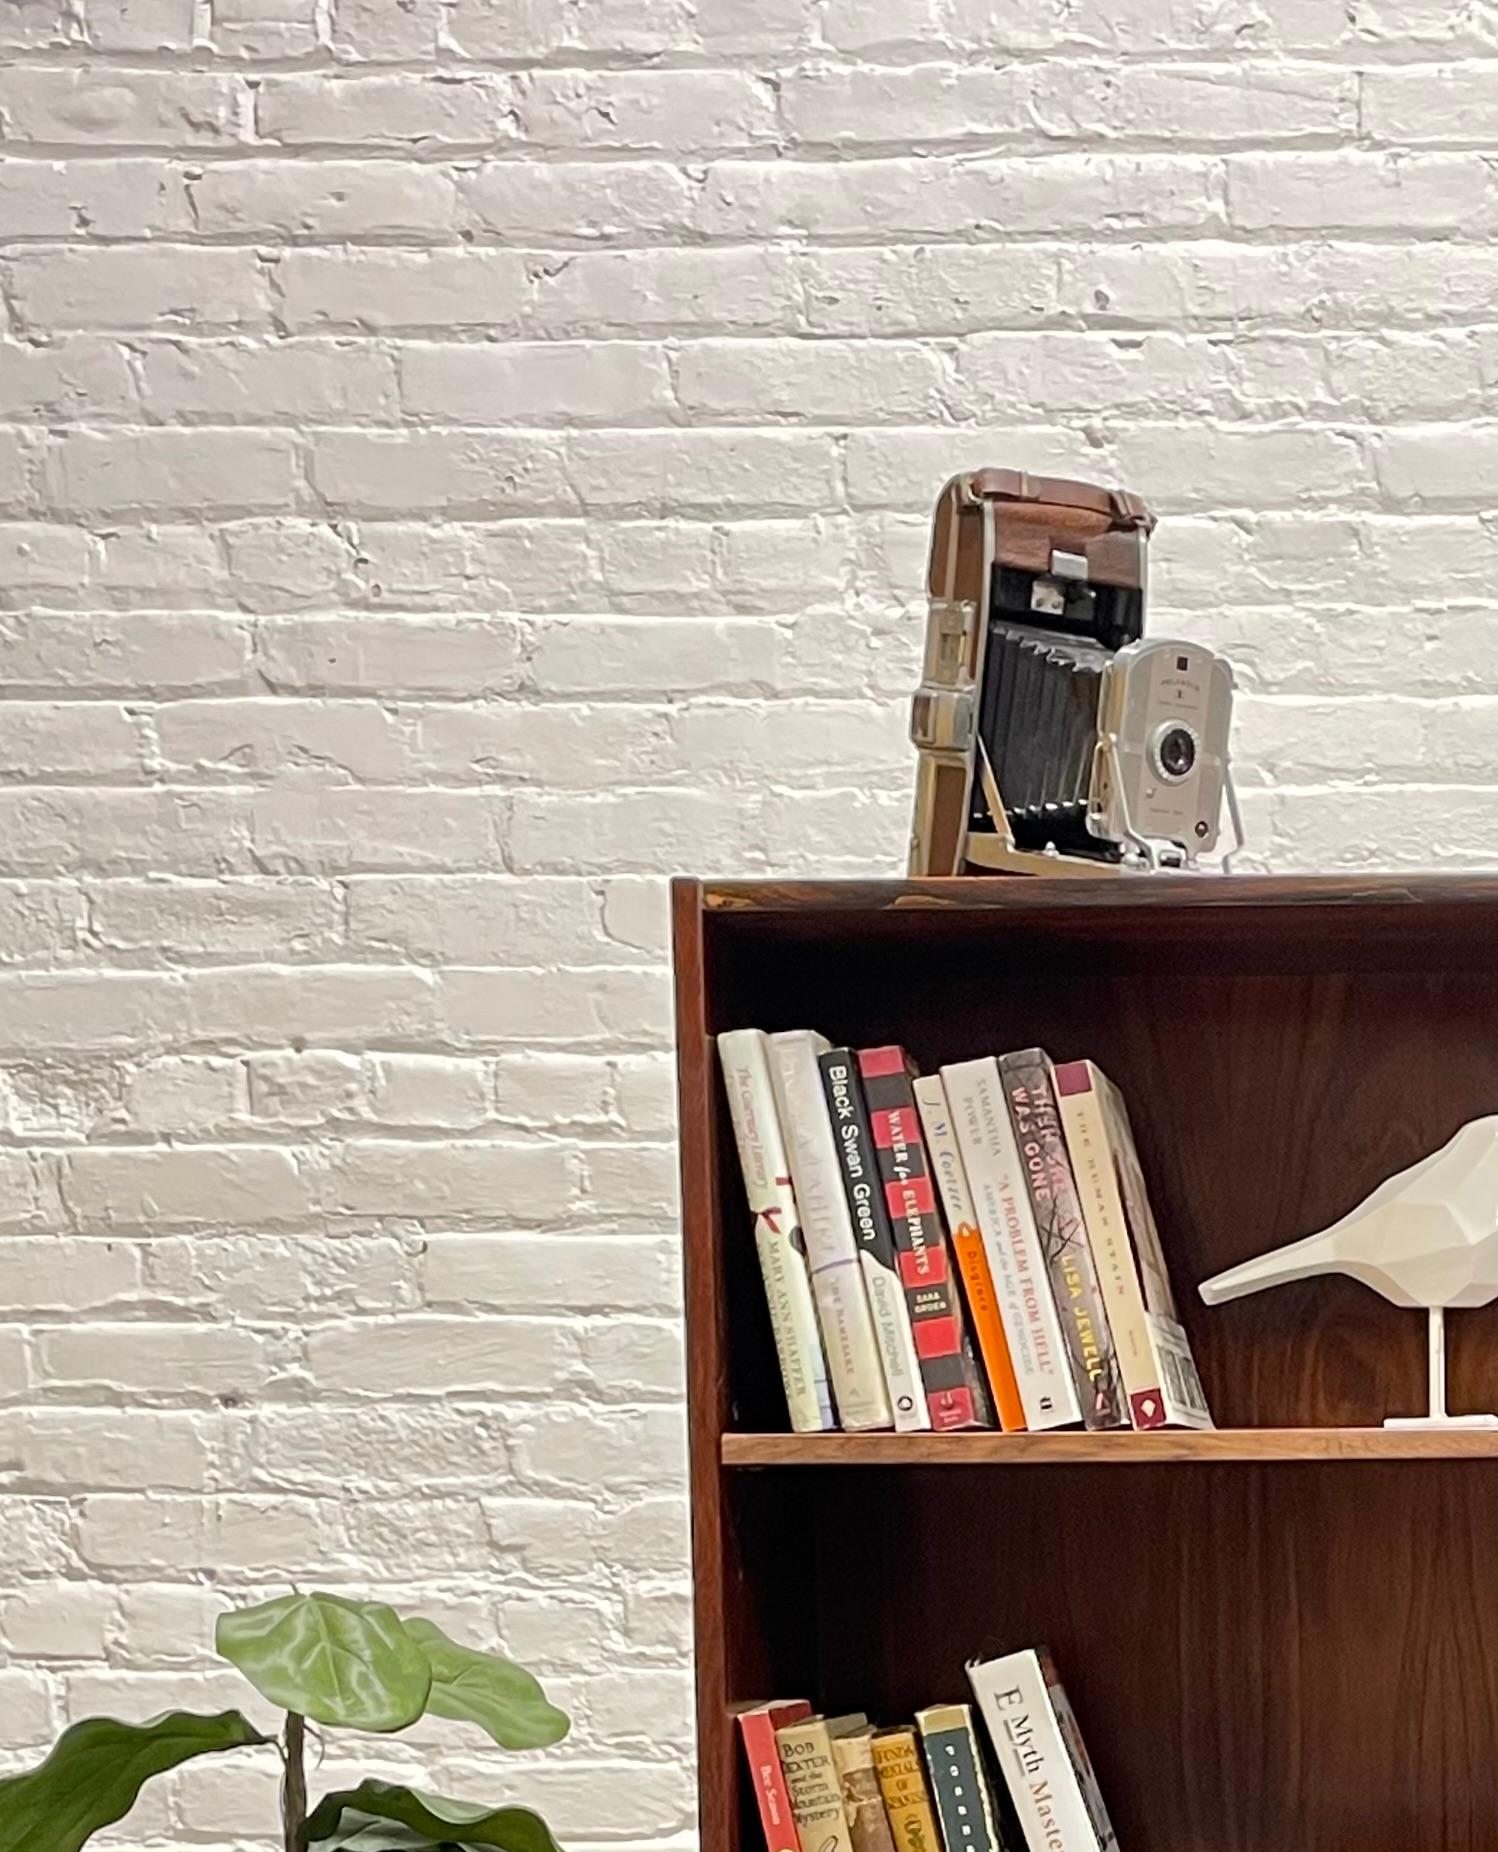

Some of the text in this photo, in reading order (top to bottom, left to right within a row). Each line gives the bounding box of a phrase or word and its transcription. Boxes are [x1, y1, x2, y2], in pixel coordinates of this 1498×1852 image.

[828, 1065, 876, 1241] Black Swan Green
[963, 1096, 982, 1145] POWER
[976, 1078, 1002, 1156] SAMANTHA
[1012, 1087, 1050, 1201] WAS GONE
[1032, 1084, 1061, 1142] THEN
[888, 1111, 909, 1163] WATER
[902, 1189, 930, 1275] ELEPHANTS
[768, 1241, 784, 1281] MARY
[777, 1289, 792, 1322] ANN
[1001, 1197, 1030, 1274] PROBLEM
[1020, 1279, 1040, 1327] FROM
[872, 1276, 903, 1377] David Mitchell
[1061, 1253, 1103, 1382] LISA JEWELL
[994, 1685, 1023, 1711] E
[1010, 1714, 1044, 1774] Myth
